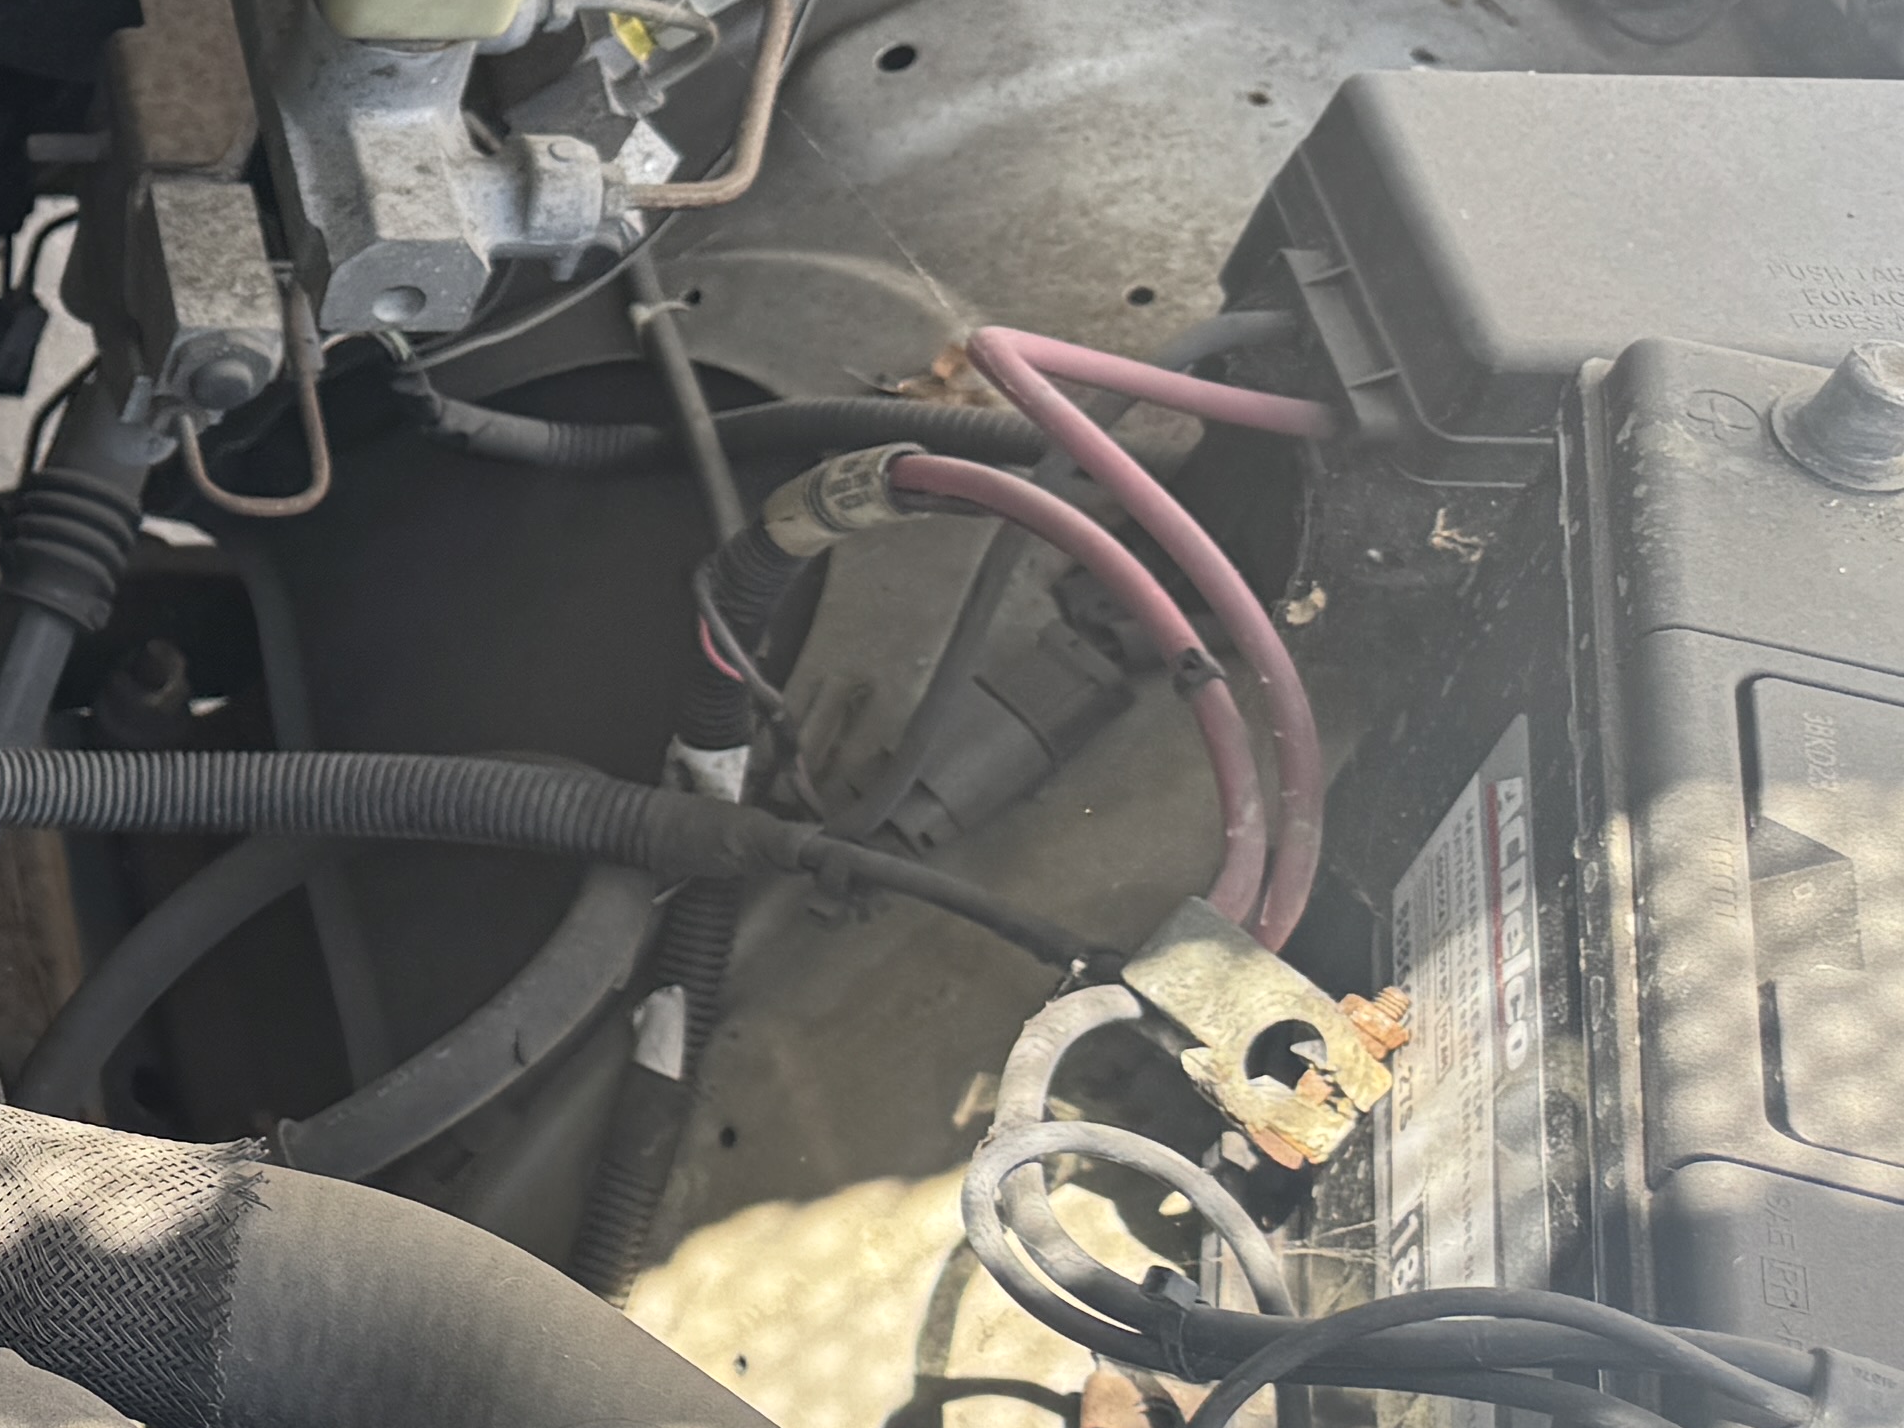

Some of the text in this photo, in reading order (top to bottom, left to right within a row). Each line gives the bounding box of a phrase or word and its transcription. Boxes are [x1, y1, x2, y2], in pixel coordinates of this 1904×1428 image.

[1767, 264, 1845, 283] PUSH
[1801, 289, 1863, 306] FOR
[1789, 313, 1884, 330] FUSES
[1495, 777, 1532, 1070] ACDelco
